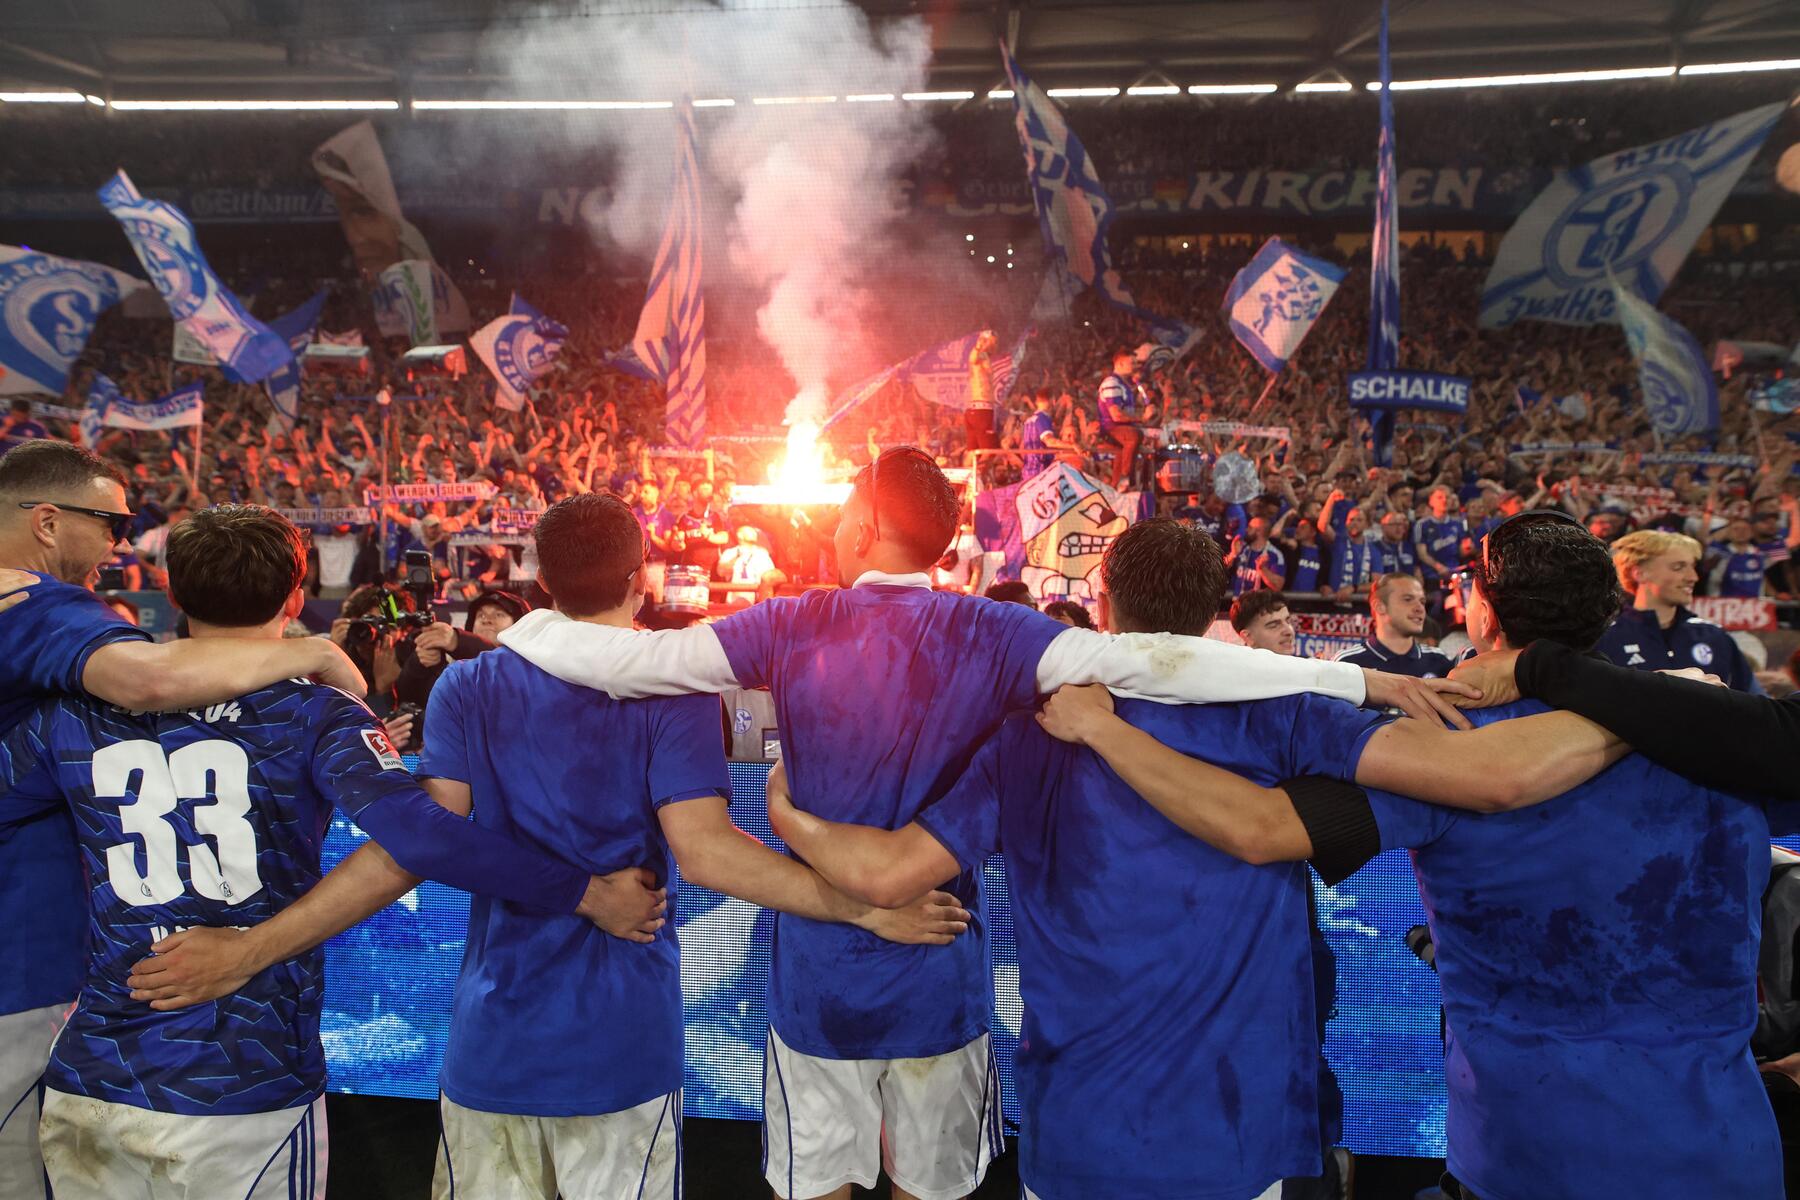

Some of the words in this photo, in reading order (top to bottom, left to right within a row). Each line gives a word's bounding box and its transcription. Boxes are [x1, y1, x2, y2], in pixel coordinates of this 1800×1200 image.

[1188, 167, 1482, 215] KIRCHEN
[1351, 376, 1468, 406] SCHALKE
[92, 738, 264, 907] 33
